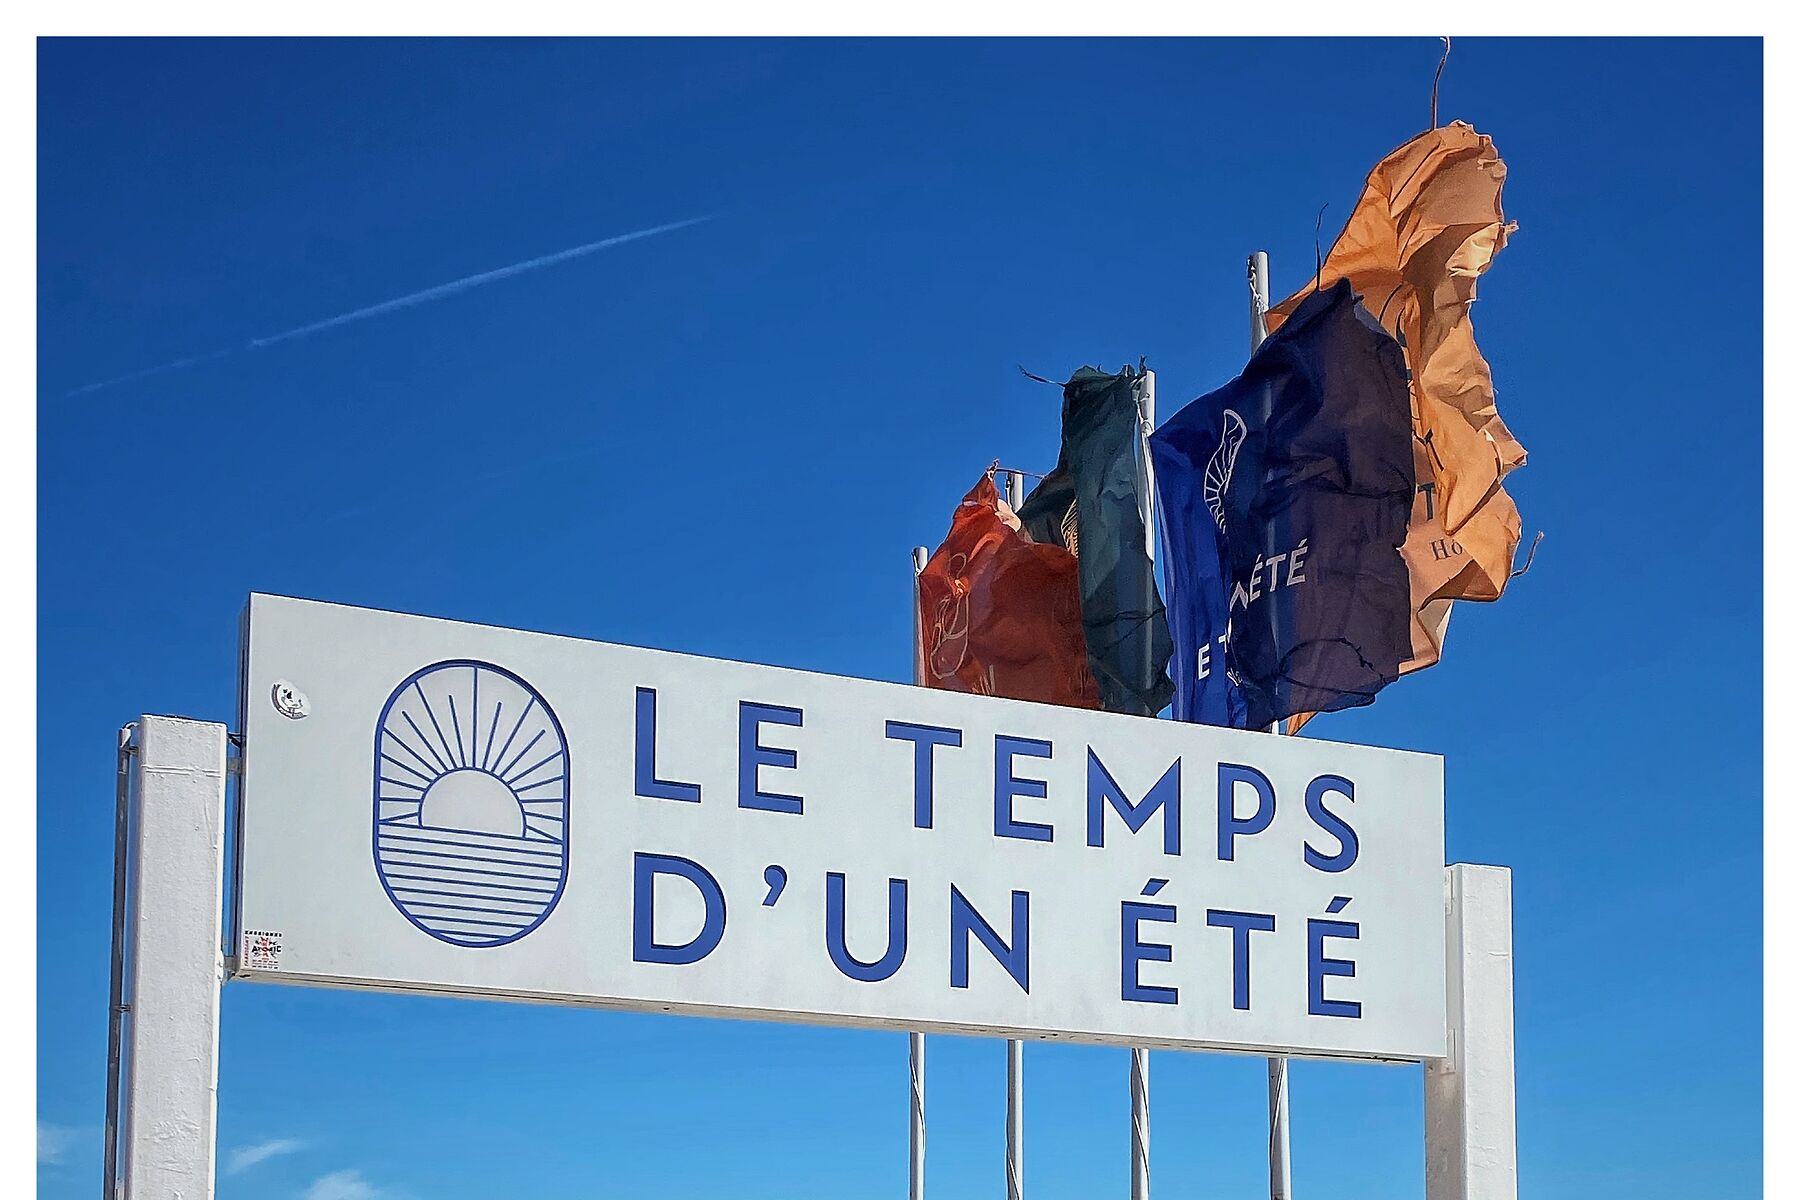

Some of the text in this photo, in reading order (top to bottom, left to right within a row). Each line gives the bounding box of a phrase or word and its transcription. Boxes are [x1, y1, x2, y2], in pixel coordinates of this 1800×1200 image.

[1249, 538, 1309, 602] ÉTÉ
[634, 687, 1360, 874] LE TEMPS
[633, 852, 1363, 1020] D'UN ÉTÉ
